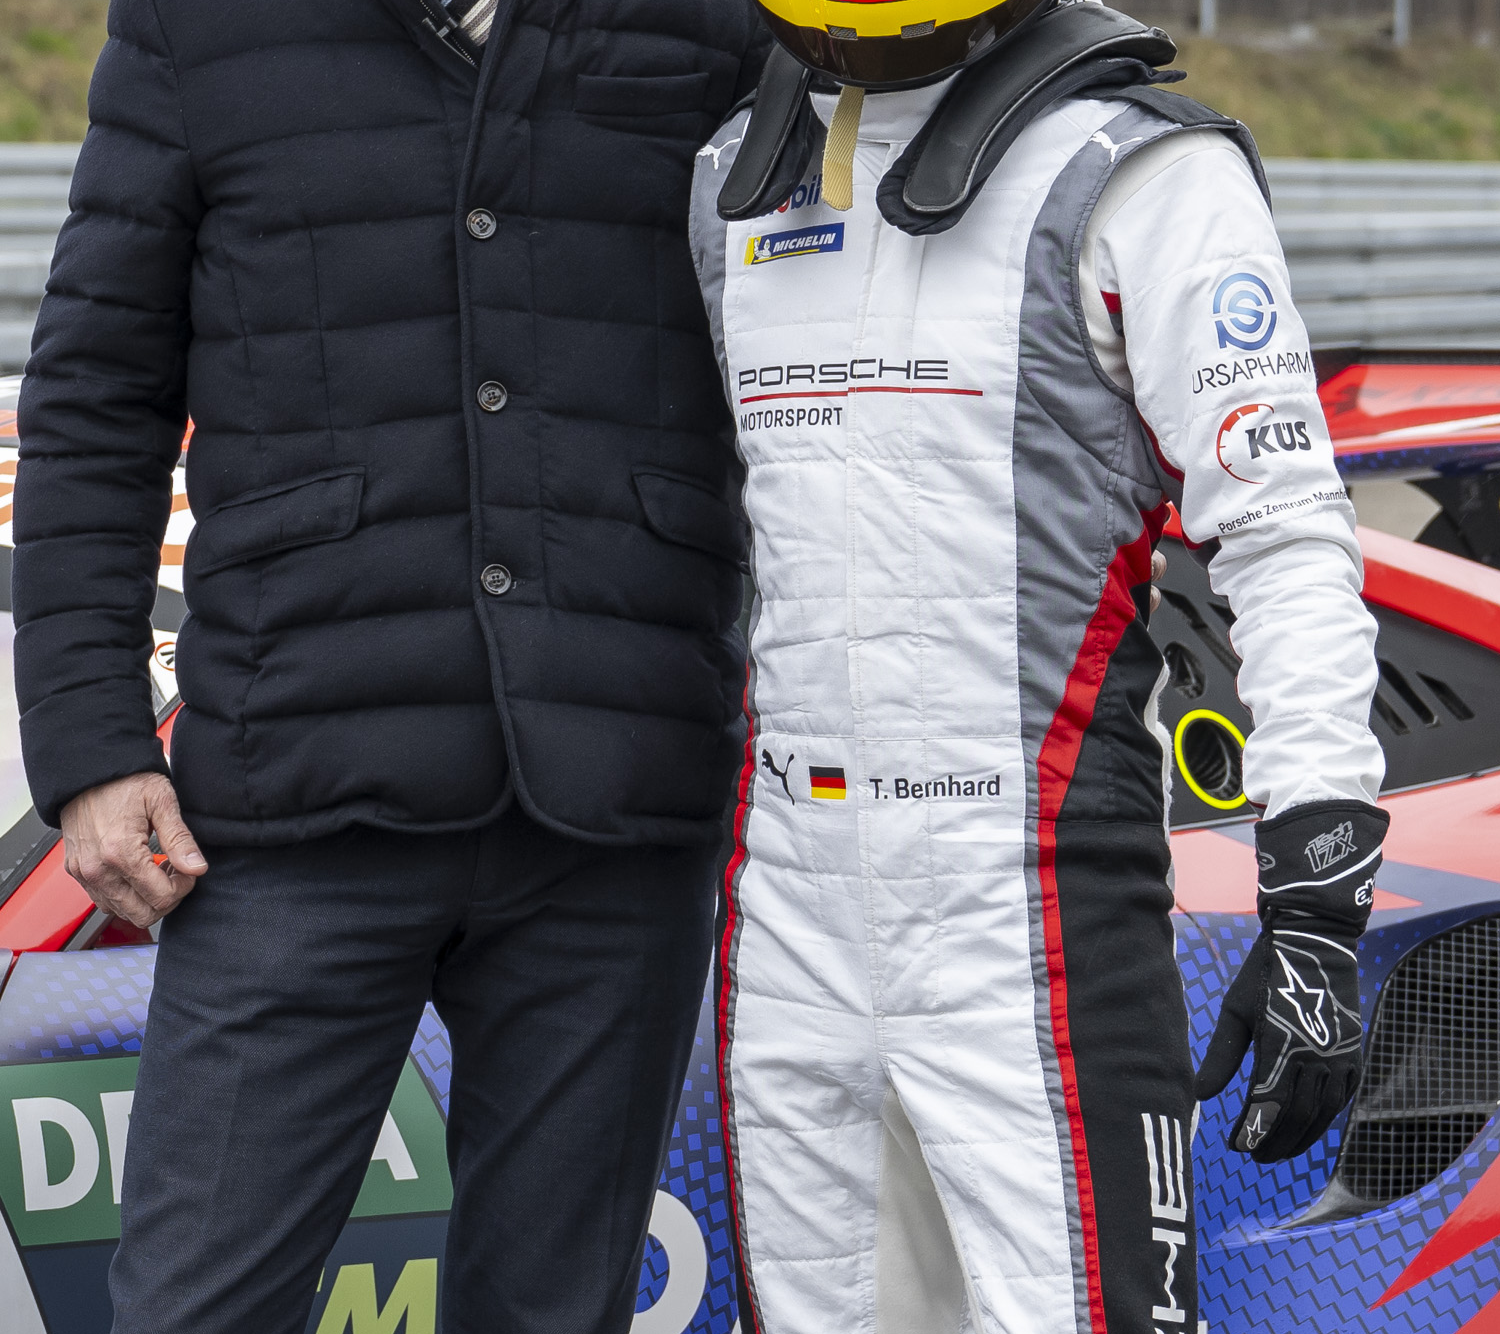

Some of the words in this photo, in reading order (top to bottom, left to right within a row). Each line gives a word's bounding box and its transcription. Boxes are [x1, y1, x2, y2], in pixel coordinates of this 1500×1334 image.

[773, 233, 836, 253] MICHELIN
[739, 358, 949, 391] PORSCHE
[1192, 351, 1312, 394] URSAPHARM
[740, 407, 843, 434] MOTORSPORT
[1245, 421, 1311, 459] KÜS
[1218, 511, 1263, 534] Porsche
[1263, 496, 1313, 515] Zentrum
[1313, 488, 1346, 503] Mannhe
[869, 777, 888, 800] T.
[895, 774, 1000, 800] Bernhard
